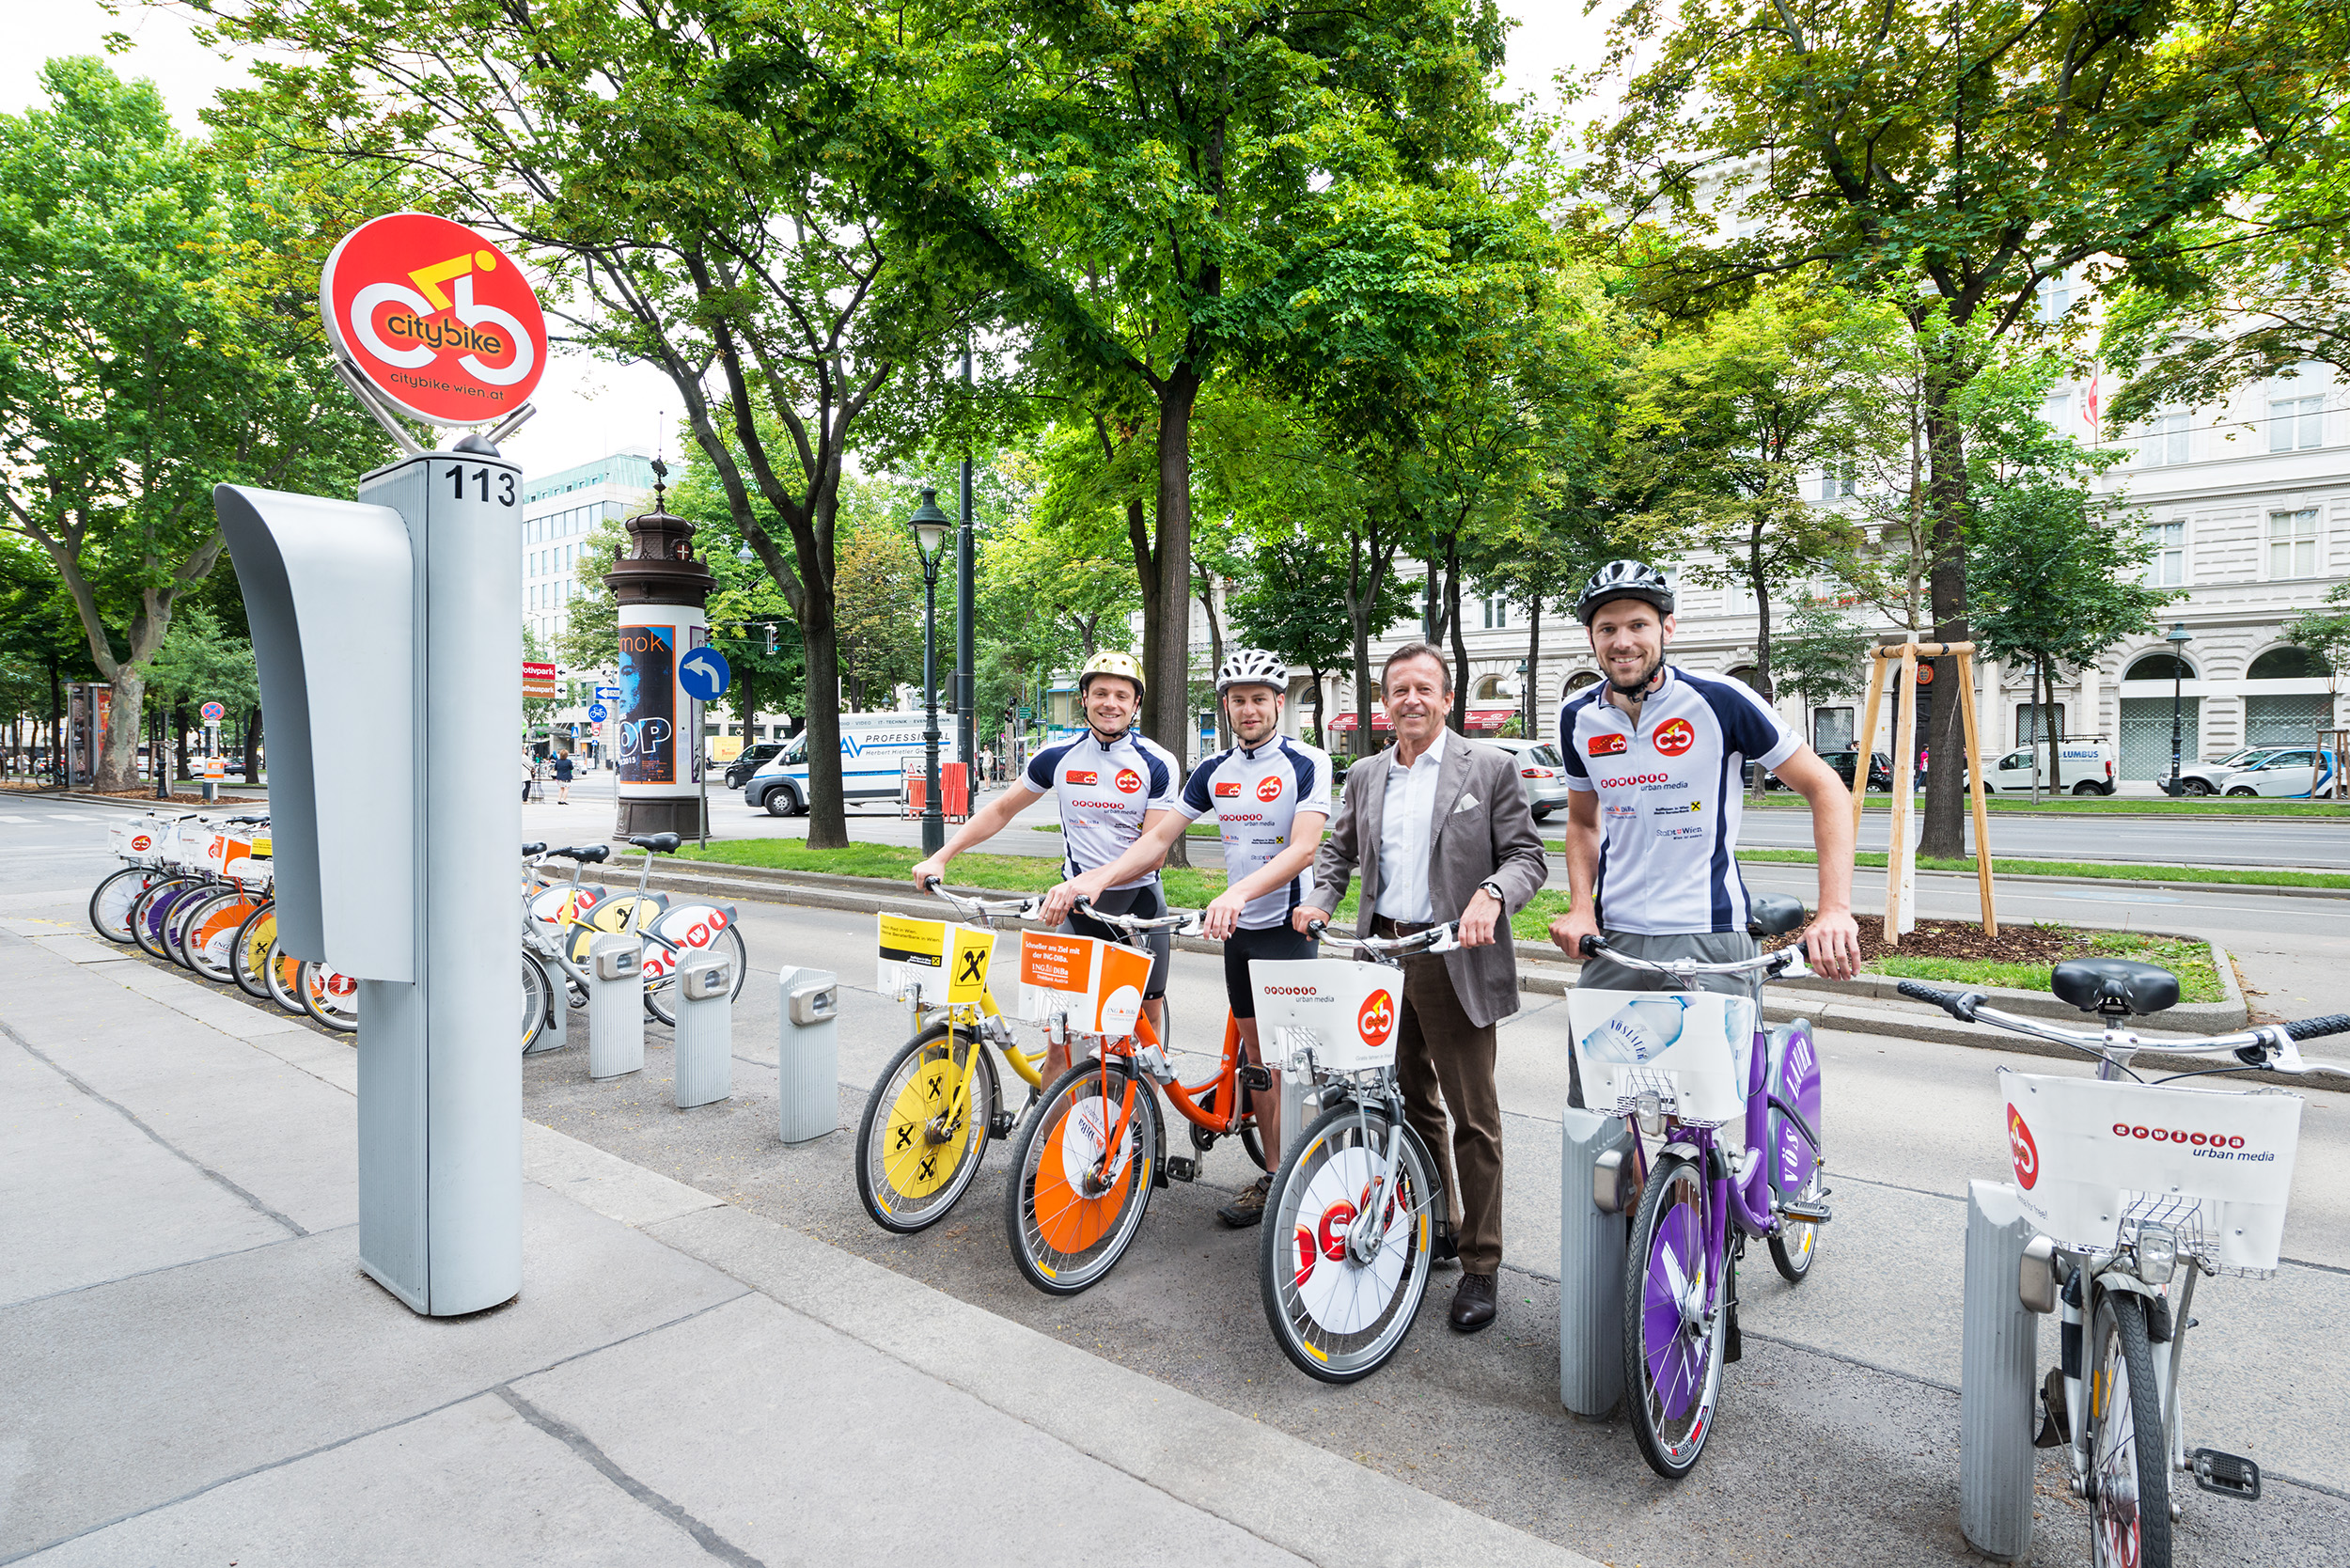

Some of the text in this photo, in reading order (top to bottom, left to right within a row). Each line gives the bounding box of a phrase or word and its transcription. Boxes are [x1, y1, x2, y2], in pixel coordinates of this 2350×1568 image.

[387, 314, 502, 354] citybike
[390, 372, 504, 400] citybike wien.at
[446, 464, 516, 508] 113
[619, 632, 665, 652] mok
[523, 666, 555, 676] otivpark
[523, 685, 555, 694] athauspark
[619, 716, 672, 758] OP
[1640, 781, 1689, 792] urban media
[1025, 940, 1047, 950] Schneller
[1053, 966, 1069, 976] DiBa
[1781, 1037, 1812, 1183] VÖS LAUER
[2112, 1122, 2245, 1150] gewista
[2192, 1148, 2275, 1162] urban media
